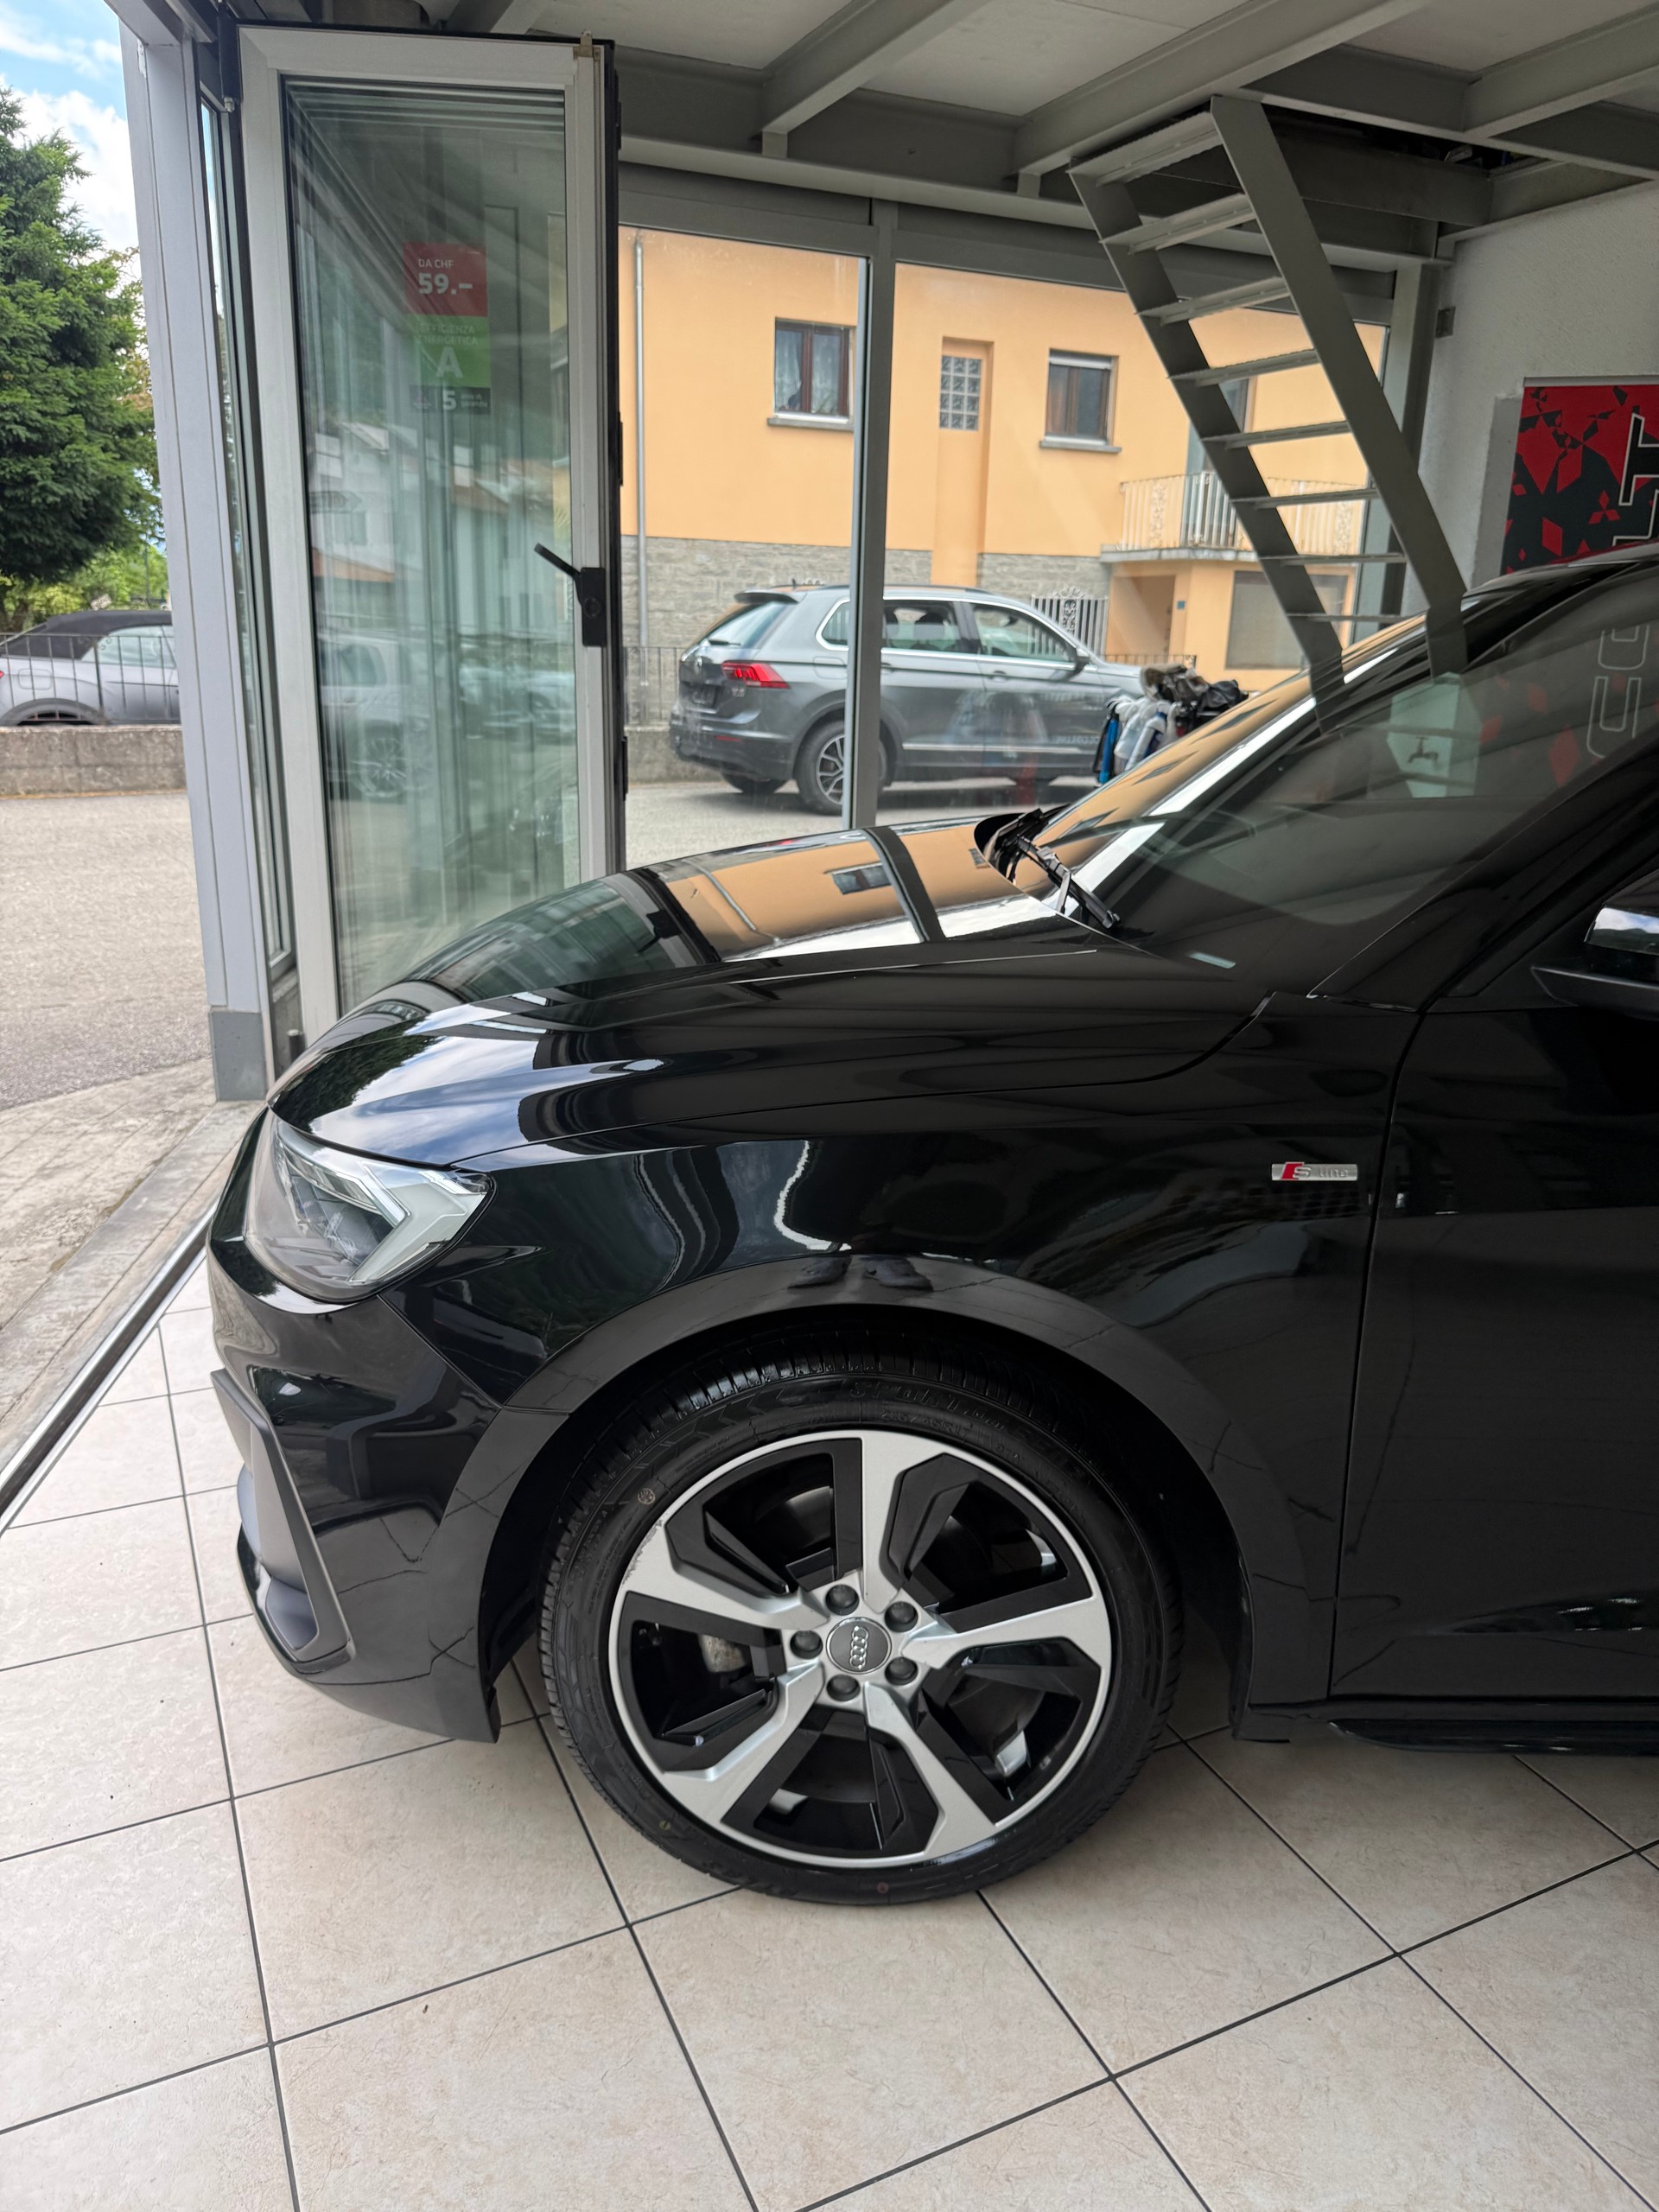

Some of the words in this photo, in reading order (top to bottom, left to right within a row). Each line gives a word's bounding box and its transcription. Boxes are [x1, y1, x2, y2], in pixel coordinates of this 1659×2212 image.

[418, 259, 432, 268] DA
[435, 260, 454, 270] CHF
[418, 272, 474, 295] 59.-
[435, 346, 464, 378] A
[442, 390, 457, 410] 5
[1319, 1166, 1348, 1178] line
